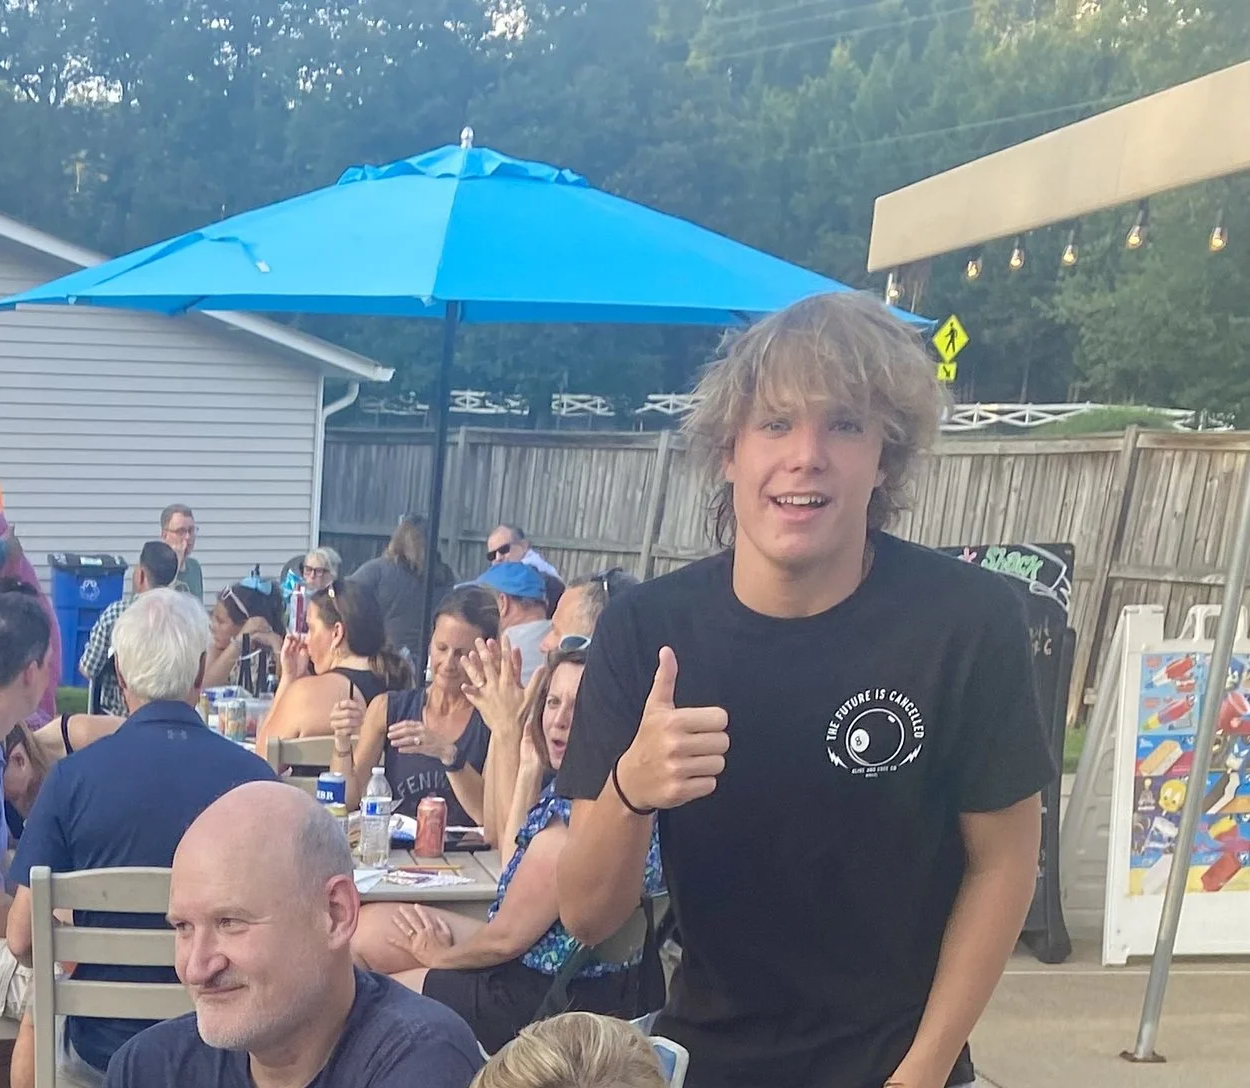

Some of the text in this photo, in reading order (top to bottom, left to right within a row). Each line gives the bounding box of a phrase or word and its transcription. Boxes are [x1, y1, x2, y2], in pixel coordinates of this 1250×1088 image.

[826, 688, 925, 741] THE FUTURE IS CANCELLED
